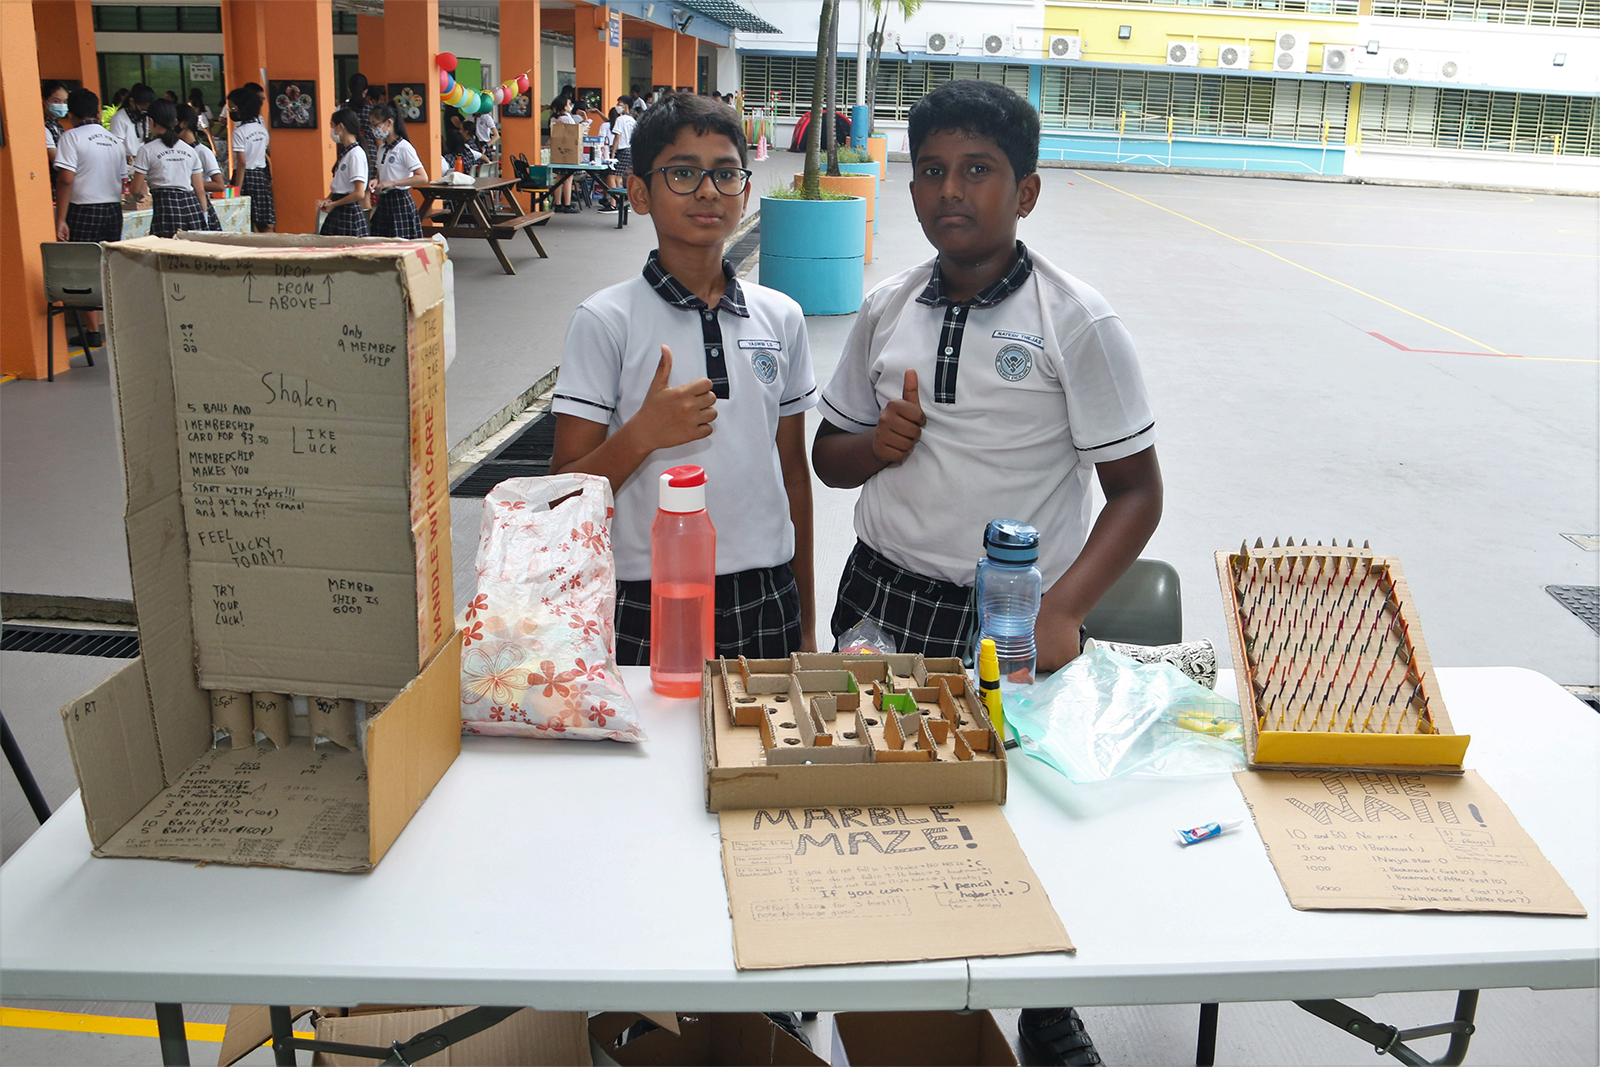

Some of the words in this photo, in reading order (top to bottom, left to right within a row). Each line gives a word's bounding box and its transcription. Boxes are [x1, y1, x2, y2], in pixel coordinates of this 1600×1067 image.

[275, 263, 312, 278] DROP
[278, 282, 314, 294] FROM
[270, 296, 317, 310] ABOVE
[342, 324, 362, 338] Only
[423, 319, 437, 342] THE
[350, 342, 396, 354] MEMBER
[362, 354, 390, 367] SHIP
[261, 372, 337, 412] Shaken
[188, 403, 196, 412] 5
[233, 404, 252, 415] AND
[191, 418, 254, 432] MEMBERSHIP
[188, 432, 213, 442] CARD
[218, 432, 234, 440] FOR
[241, 432, 269, 445] $3.50
[425, 406, 434, 476] CARE
[189, 450, 254, 464] MEMBERSHIP
[192, 466, 226, 477] MAKES
[231, 465, 249, 476] YOU
[192, 482, 220, 492] START
[226, 486, 252, 495] WITH
[194, 496, 214, 506] and
[218, 498, 236, 510] get
[252, 499, 271, 508] free
[196, 508, 216, 518] and
[234, 508, 266, 519] heart!
[426, 486, 438, 542] WITH
[198, 530, 234, 546] FEEL
[230, 536, 272, 555] LUCKY
[232, 549, 286, 568] TODAY?
[213, 585, 235, 597] TRY
[328, 578, 374, 592] MEMBER
[332, 594, 357, 606] SHIP
[364, 594, 379, 606] IS
[429, 544, 442, 644] HANDLE
[213, 600, 238, 612] YOUR
[332, 606, 362, 614] GOOD
[215, 612, 245, 627] LUCK!
[74, 708, 80, 721] 6
[84, 700, 96, 716] RT
[1290, 770, 1432, 797] THE
[754, 805, 960, 830] MARBLE
[794, 826, 978, 856] MAZE!
[1286, 828, 1307, 840] 10
[1330, 830, 1346, 839] 50
[1356, 831, 1372, 840] No
[1369, 844, 1414, 852] Bookmark
[1376, 856, 1409, 864] Ninja
[820, 890, 837, 898] If
[848, 890, 874, 899] you
[956, 880, 992, 890] pencil
[1408, 894, 1438, 902] Ninja
